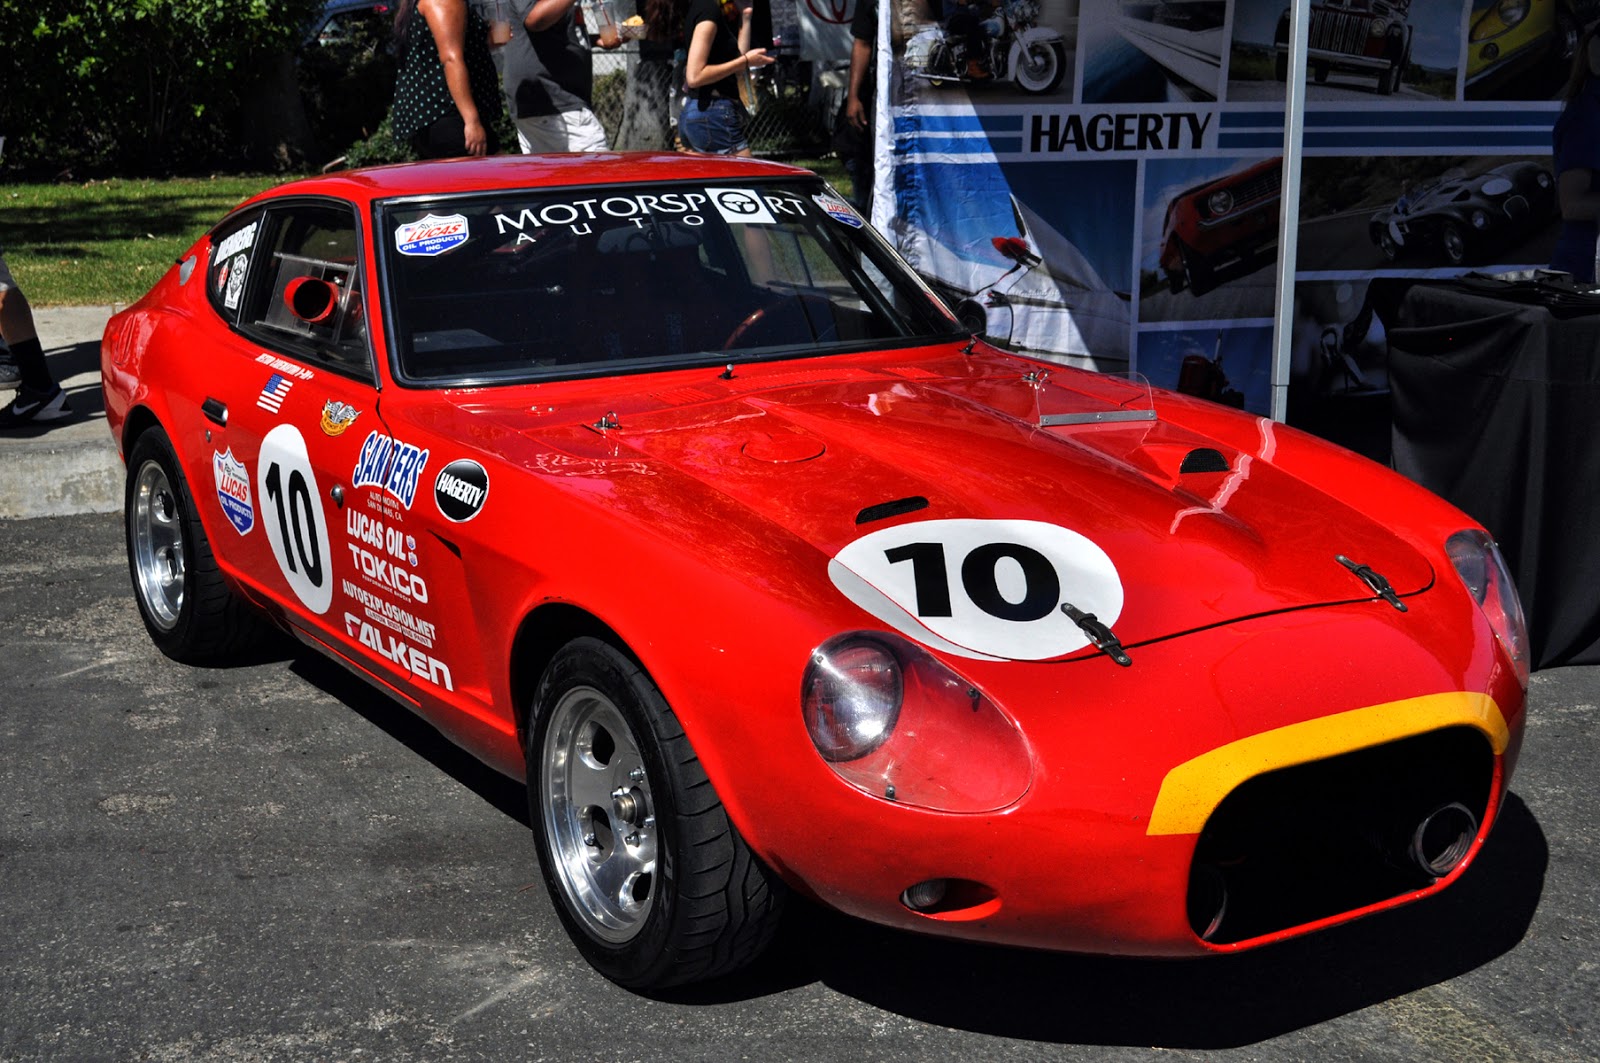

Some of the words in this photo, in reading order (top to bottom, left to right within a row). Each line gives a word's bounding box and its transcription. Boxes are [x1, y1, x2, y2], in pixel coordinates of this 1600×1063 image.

[1030, 112, 1212, 152] HAGERTY
[407, 224, 462, 242] LUCAS
[419, 235, 464, 247] PRODUCTS
[220, 475, 248, 502] LUCAS
[353, 431, 429, 509] SANDERS
[437, 472, 485, 508] HAGERTY
[228, 500, 253, 520] PRODUCTS
[265, 461, 323, 588] 10
[347, 507, 384, 550] LUCAS
[386, 527, 406, 561] OIL
[348, 542, 428, 604] TOKICO
[884, 542, 1060, 622] 10
[342, 578, 436, 640] AUTOEXPLOSION.NET
[344, 612, 453, 692] FALKEN
